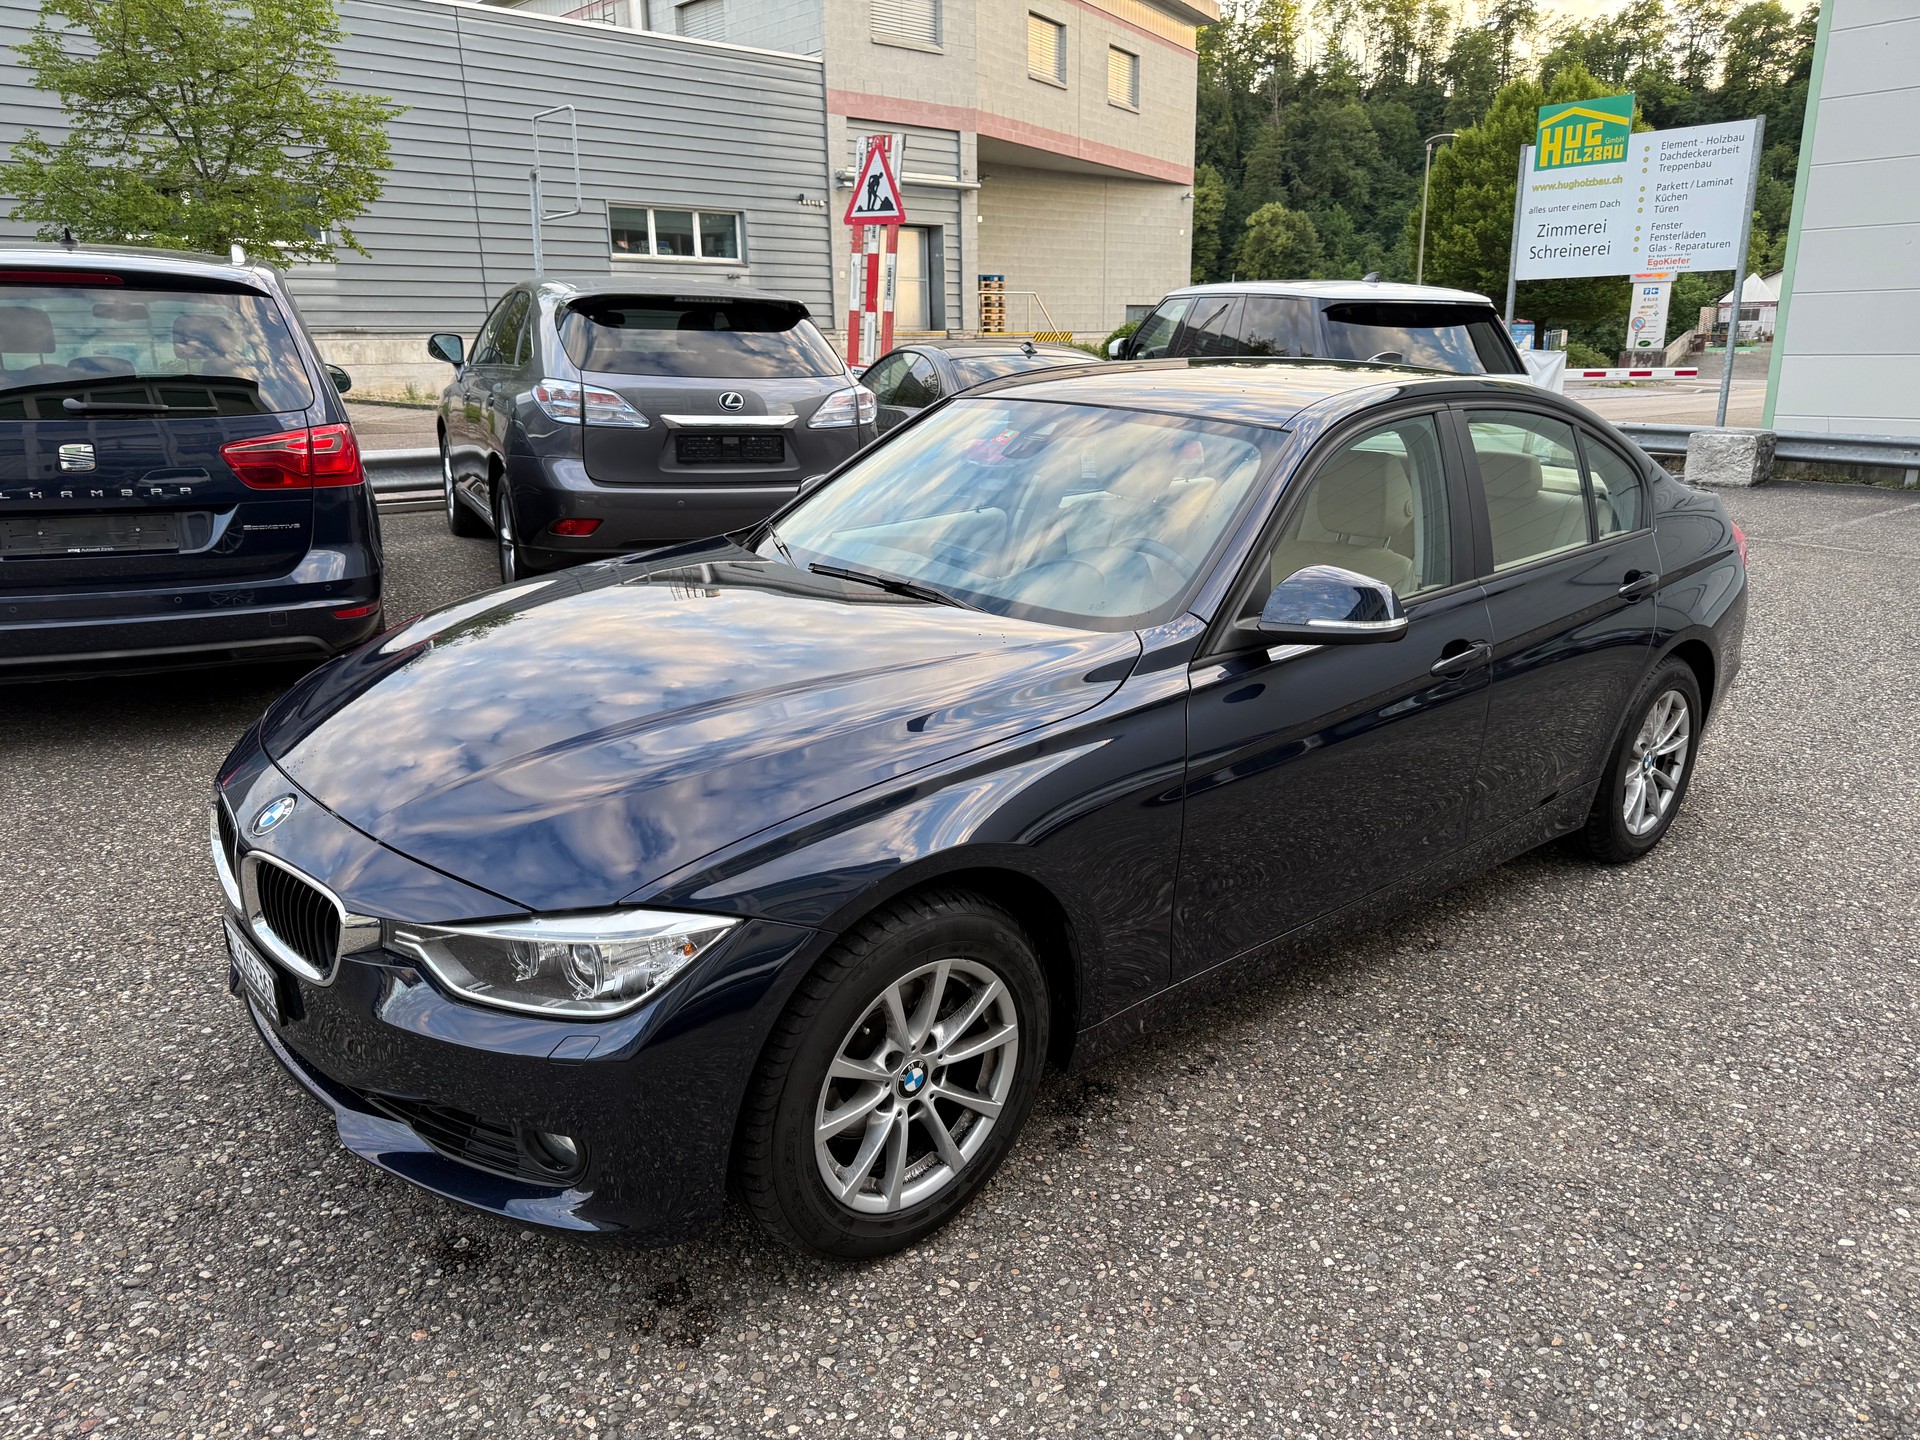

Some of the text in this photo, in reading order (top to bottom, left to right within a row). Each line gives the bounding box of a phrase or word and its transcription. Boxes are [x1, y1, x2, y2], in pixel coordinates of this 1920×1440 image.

[1605, 136, 1625, 145] GmbH
[1661, 139, 1698, 151] Element
[1706, 134, 1745, 146] Holzbau
[1660, 145, 1740, 162] Dachdeckerarbeit
[1659, 160, 1712, 173] Treppenbau
[1532, 175, 1624, 192] www.hugholzbau.ch
[1656, 182, 1689, 192] Parkett
[1696, 177, 1733, 188] Laminat
[1655, 193, 1688, 203] Küchen
[1528, 199, 1621, 215] alles unter einem Dach
[1654, 204, 1679, 214] Türen
[1537, 219, 1607, 238] Zimmerei
[1651, 222, 1683, 231] Fenster
[1649, 231, 1706, 242] Fensterläden
[1529, 240, 1612, 260] Schreinerei
[1648, 244, 1667, 253] Glas
[1675, 241, 1731, 252] Reparaturen
[1647, 257, 1691, 267] EgoKiefer
